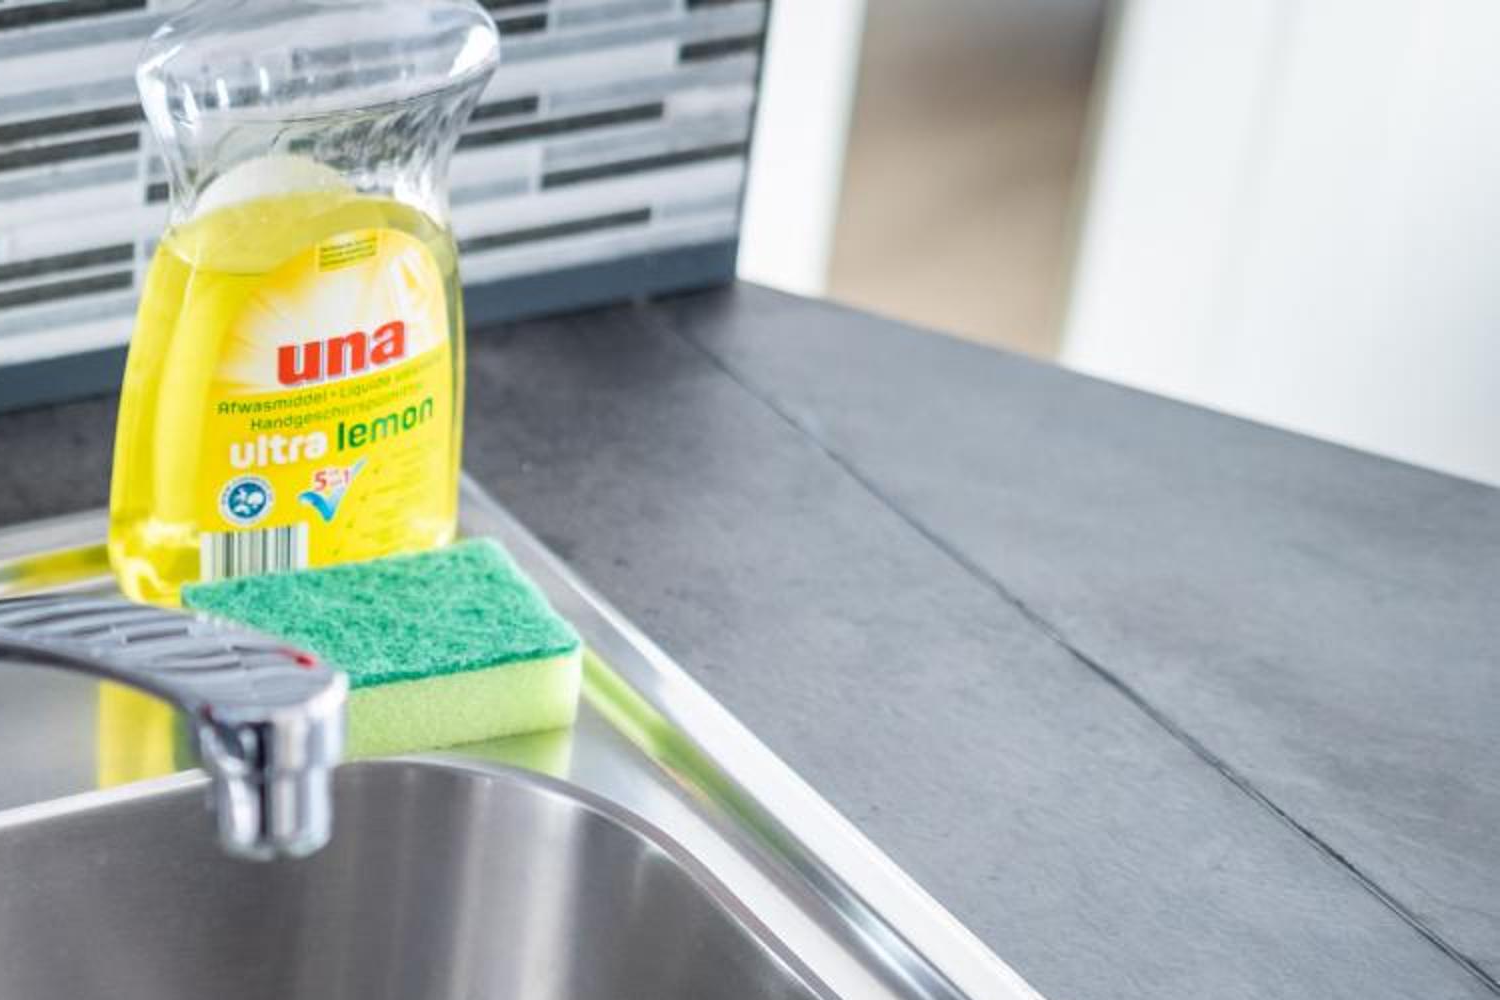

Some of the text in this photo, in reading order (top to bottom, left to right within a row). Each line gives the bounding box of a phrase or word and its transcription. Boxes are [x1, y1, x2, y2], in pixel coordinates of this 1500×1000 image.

[278, 320, 405, 386] una
[229, 396, 434, 469] ultra lemon
